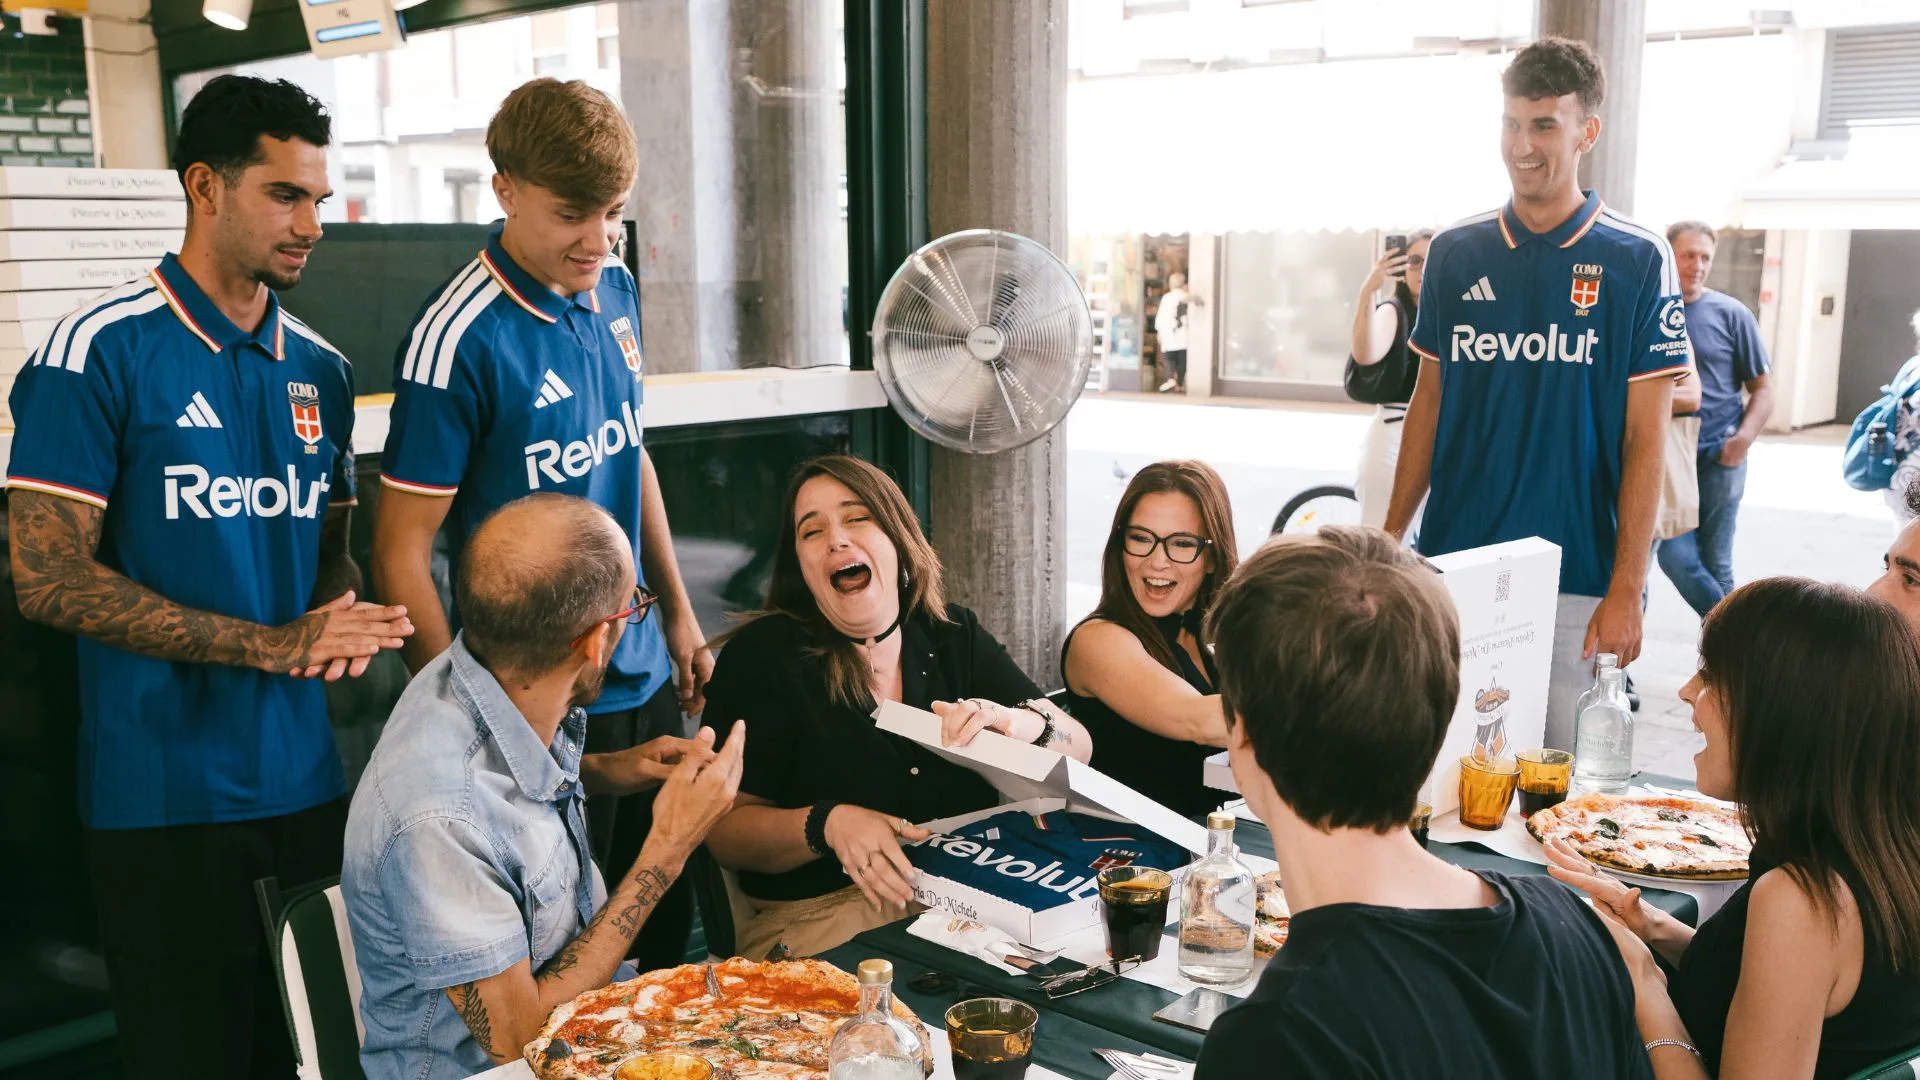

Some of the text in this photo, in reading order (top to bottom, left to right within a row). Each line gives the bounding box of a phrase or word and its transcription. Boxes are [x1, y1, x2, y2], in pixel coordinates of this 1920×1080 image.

[1573, 263, 1603, 274] COMO
[1451, 323, 1599, 365] Revolut
[1650, 341, 1687, 352] POKERS
[287, 381, 319, 397] COMO
[524, 401, 643, 490] Revol
[926, 889, 942, 907] Da
[944, 896, 978, 920] Michele
